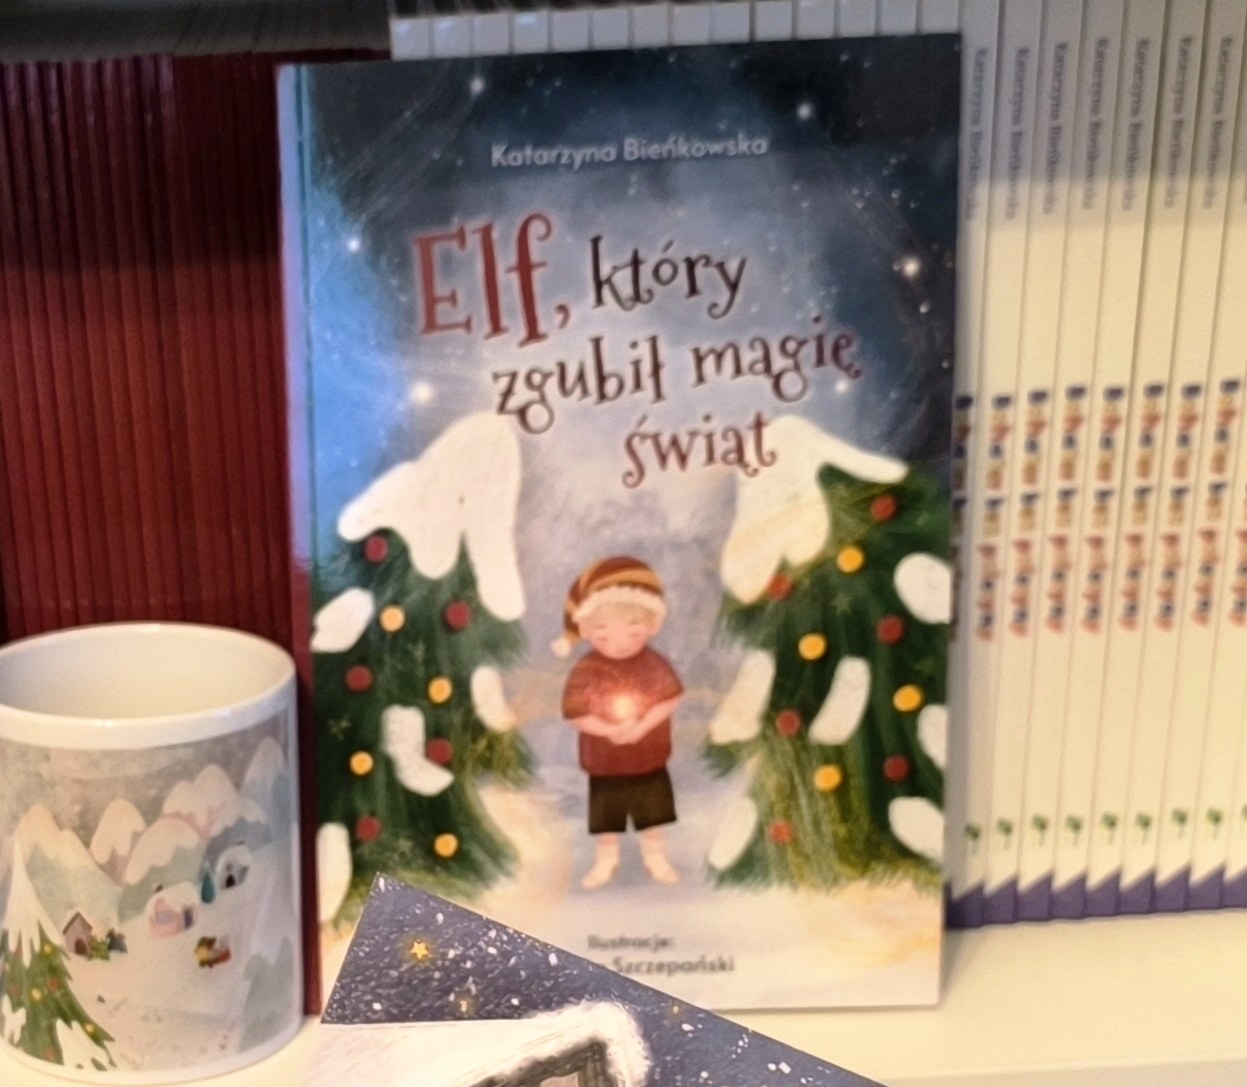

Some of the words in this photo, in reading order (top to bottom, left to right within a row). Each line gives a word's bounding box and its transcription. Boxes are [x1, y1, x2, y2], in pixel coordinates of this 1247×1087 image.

[491, 141, 618, 172] Katarzyna
[624, 132, 769, 161] Bieńkowska
[413, 212, 571, 348] Elf,
[589, 233, 748, 320] który
[491, 335, 666, 435] zgubił
[690, 315, 863, 402] magię
[621, 411, 778, 490] świąt
[613, 955, 735, 978] Szczepański
